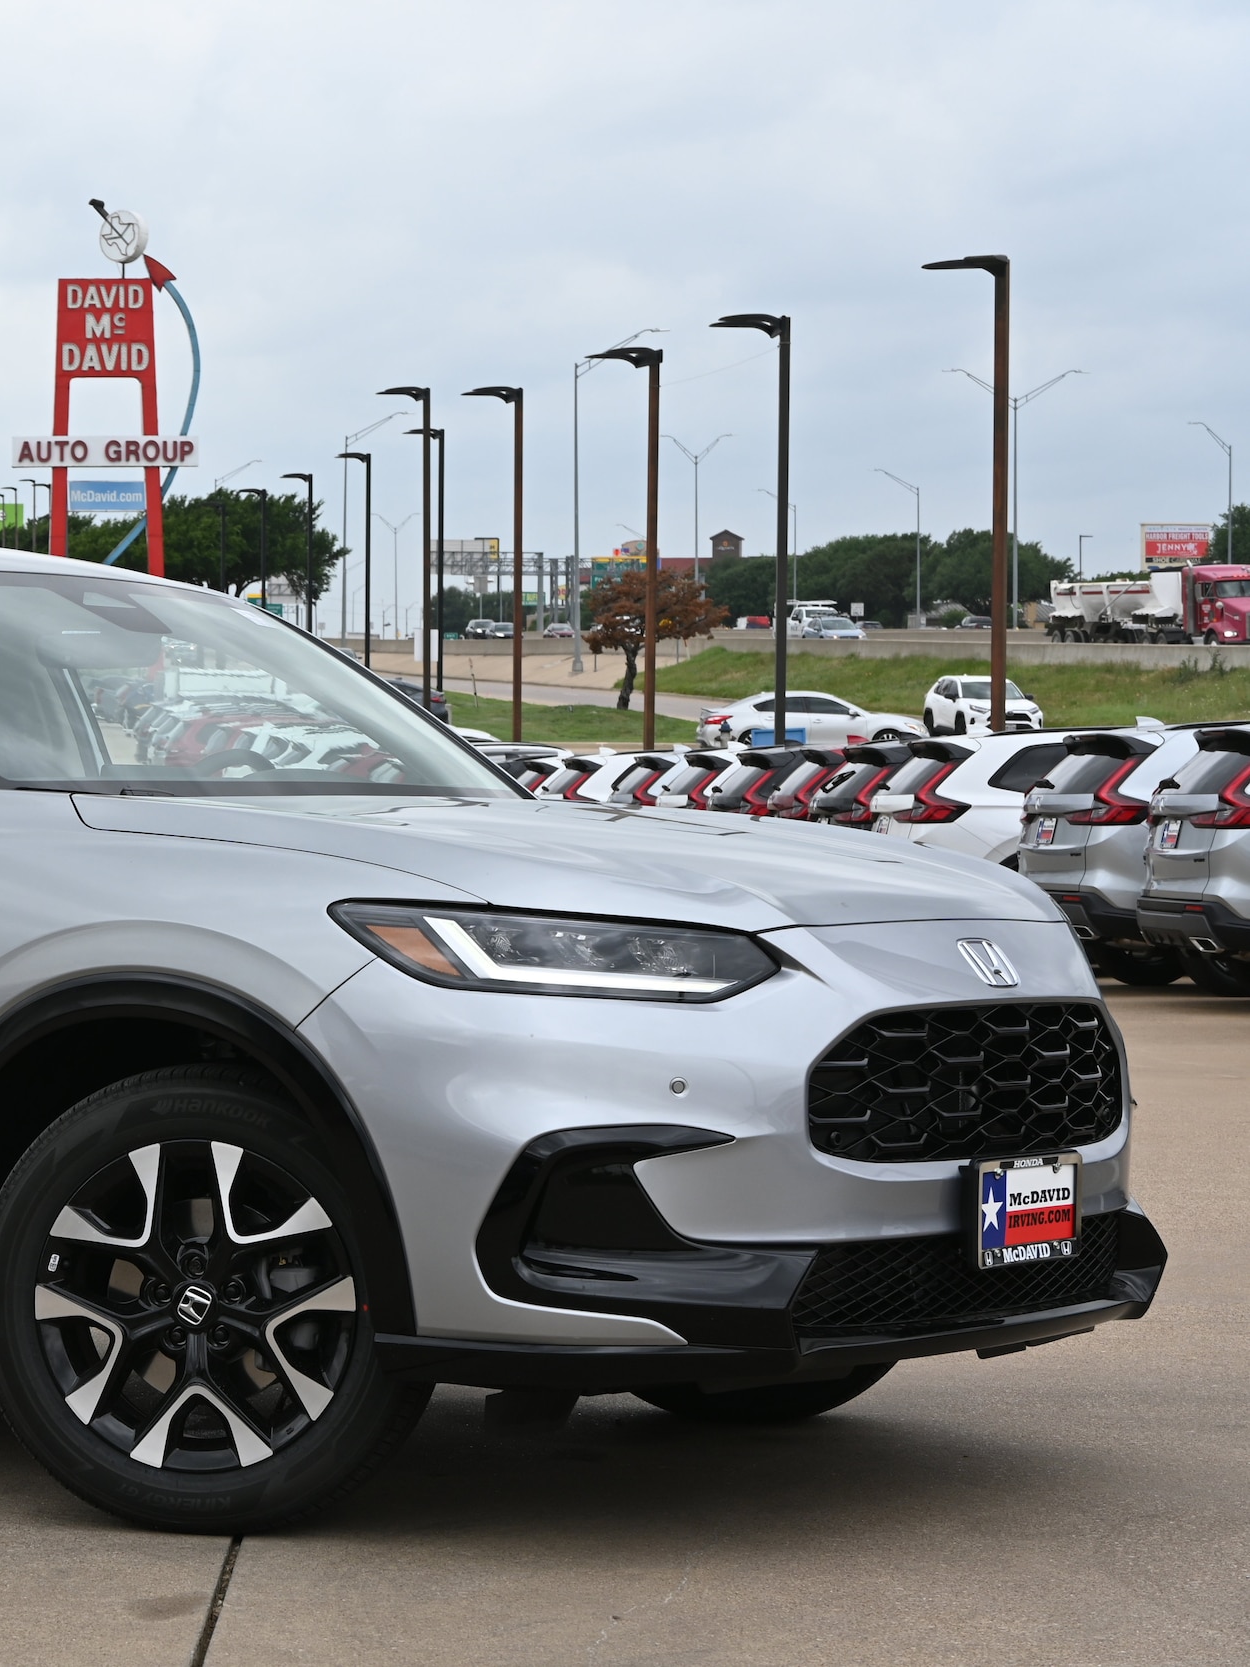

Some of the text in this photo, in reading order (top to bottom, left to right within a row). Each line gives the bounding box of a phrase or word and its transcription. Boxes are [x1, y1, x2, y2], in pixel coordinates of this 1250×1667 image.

[67, 284, 144, 309] DAVID
[62, 342, 149, 371] DAVID
[18, 440, 194, 463] AUTO GROUP
[70, 490, 143, 503] McDavid.com
[1013, 1158, 1044, 1168] HONDA
[1009, 1187, 1070, 1206] McDAVID
[1008, 1209, 1070, 1229] IRVING.COM
[1002, 1243, 1050, 1263] McDAVID
